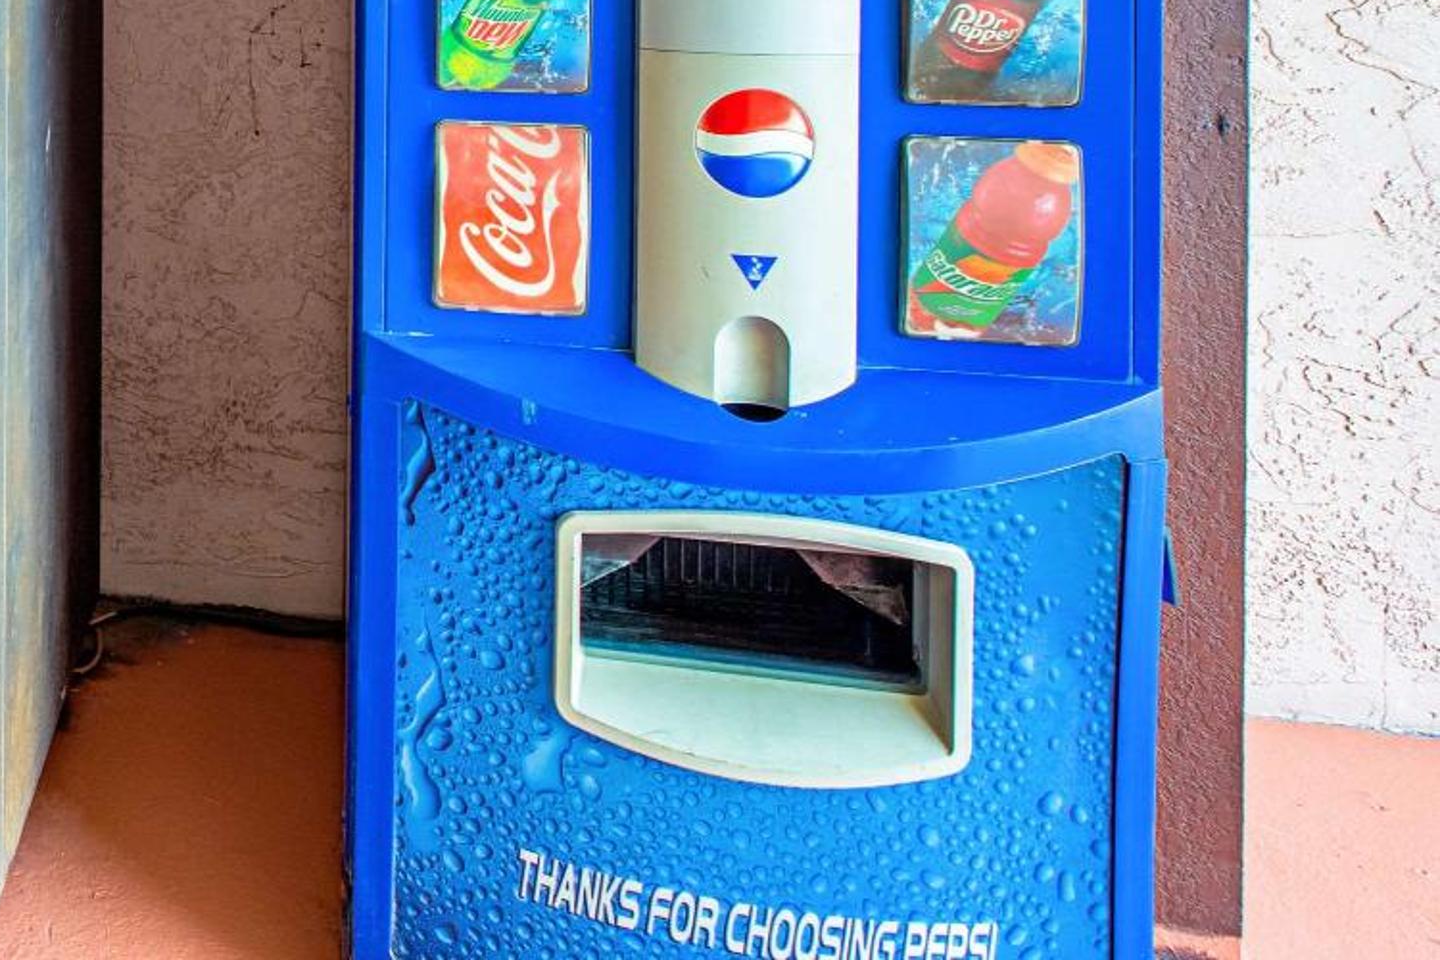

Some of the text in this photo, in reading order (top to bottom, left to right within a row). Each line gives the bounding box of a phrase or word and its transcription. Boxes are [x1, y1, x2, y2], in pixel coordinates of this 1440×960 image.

[948, 3, 1017, 45] Pepper
[977, 10, 1008, 30] Dr
[517, 849, 999, 960] THANKS FOR CHOOSING PEPSI
